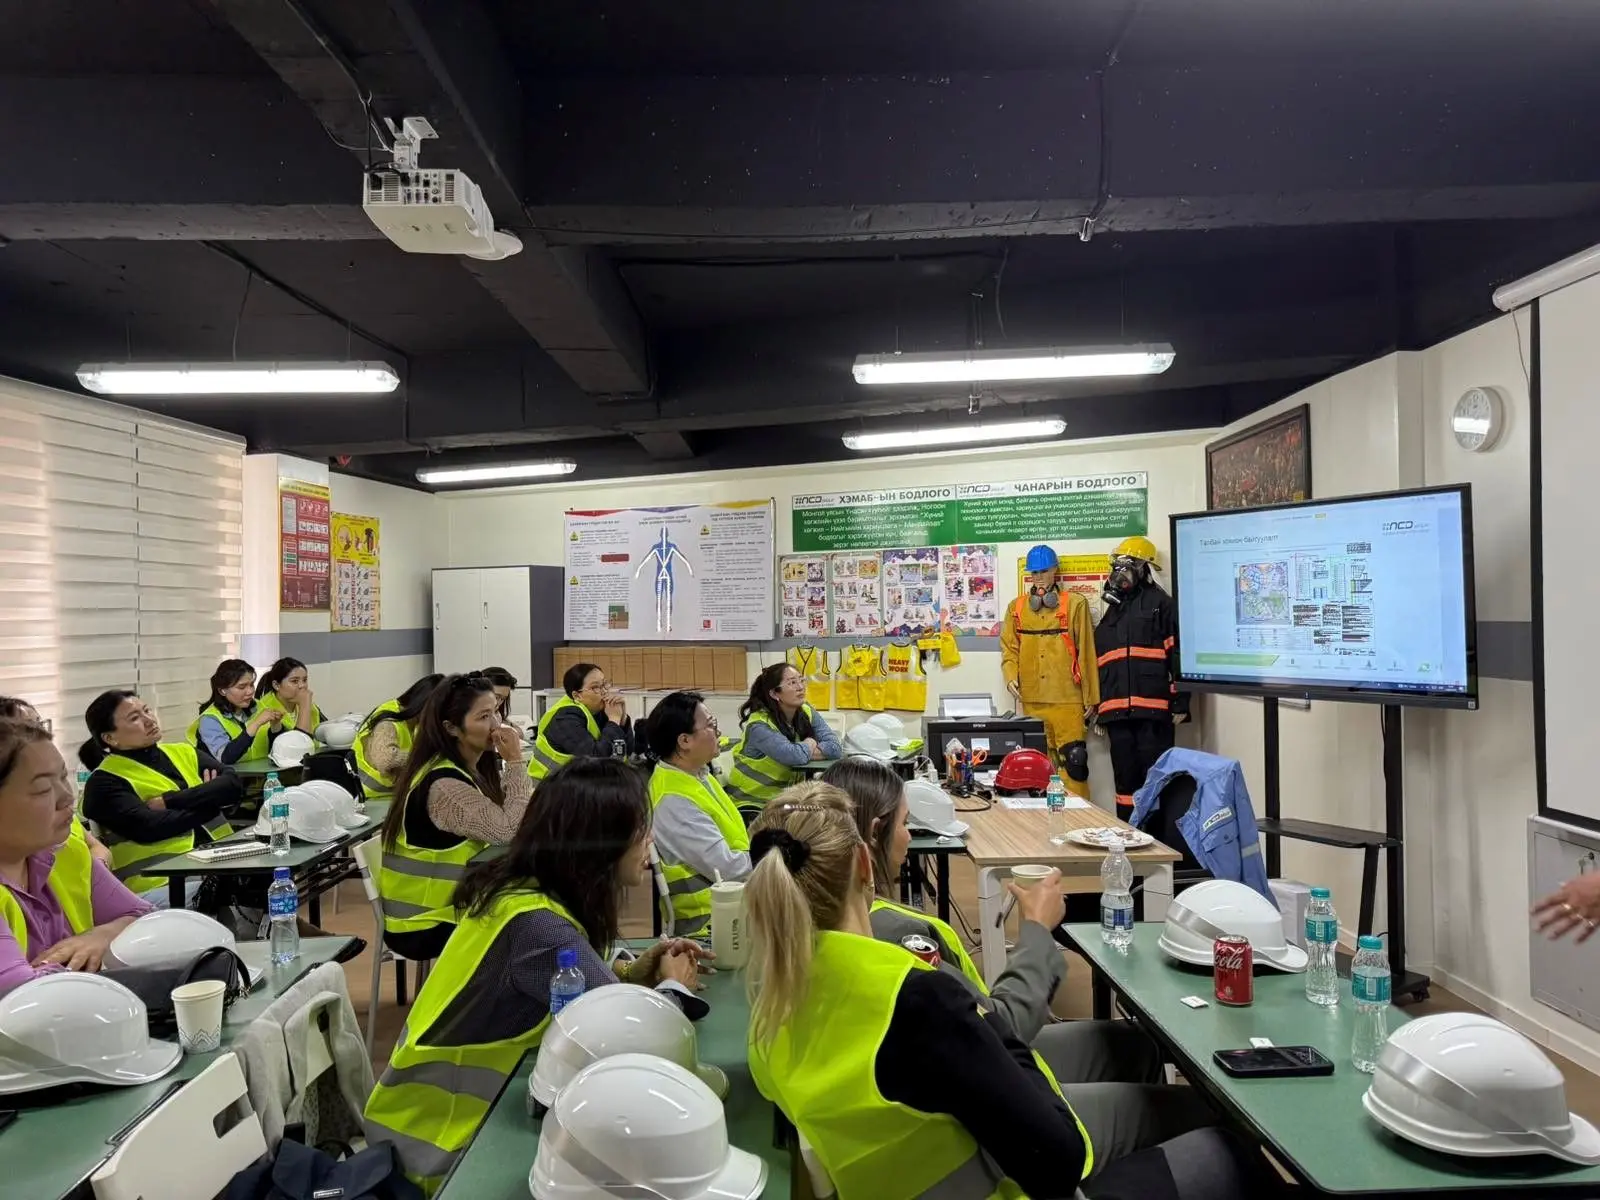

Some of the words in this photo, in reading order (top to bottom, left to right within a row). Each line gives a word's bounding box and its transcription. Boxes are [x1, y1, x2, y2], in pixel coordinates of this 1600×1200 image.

[1014, 480, 1073, 492] ЧАНАРЫН
[1076, 476, 1136, 488] БОДЛОГО
[839, 492, 896, 504] ХЭМАБ-ЫН
[899, 488, 951, 500] БОДЛОГО
